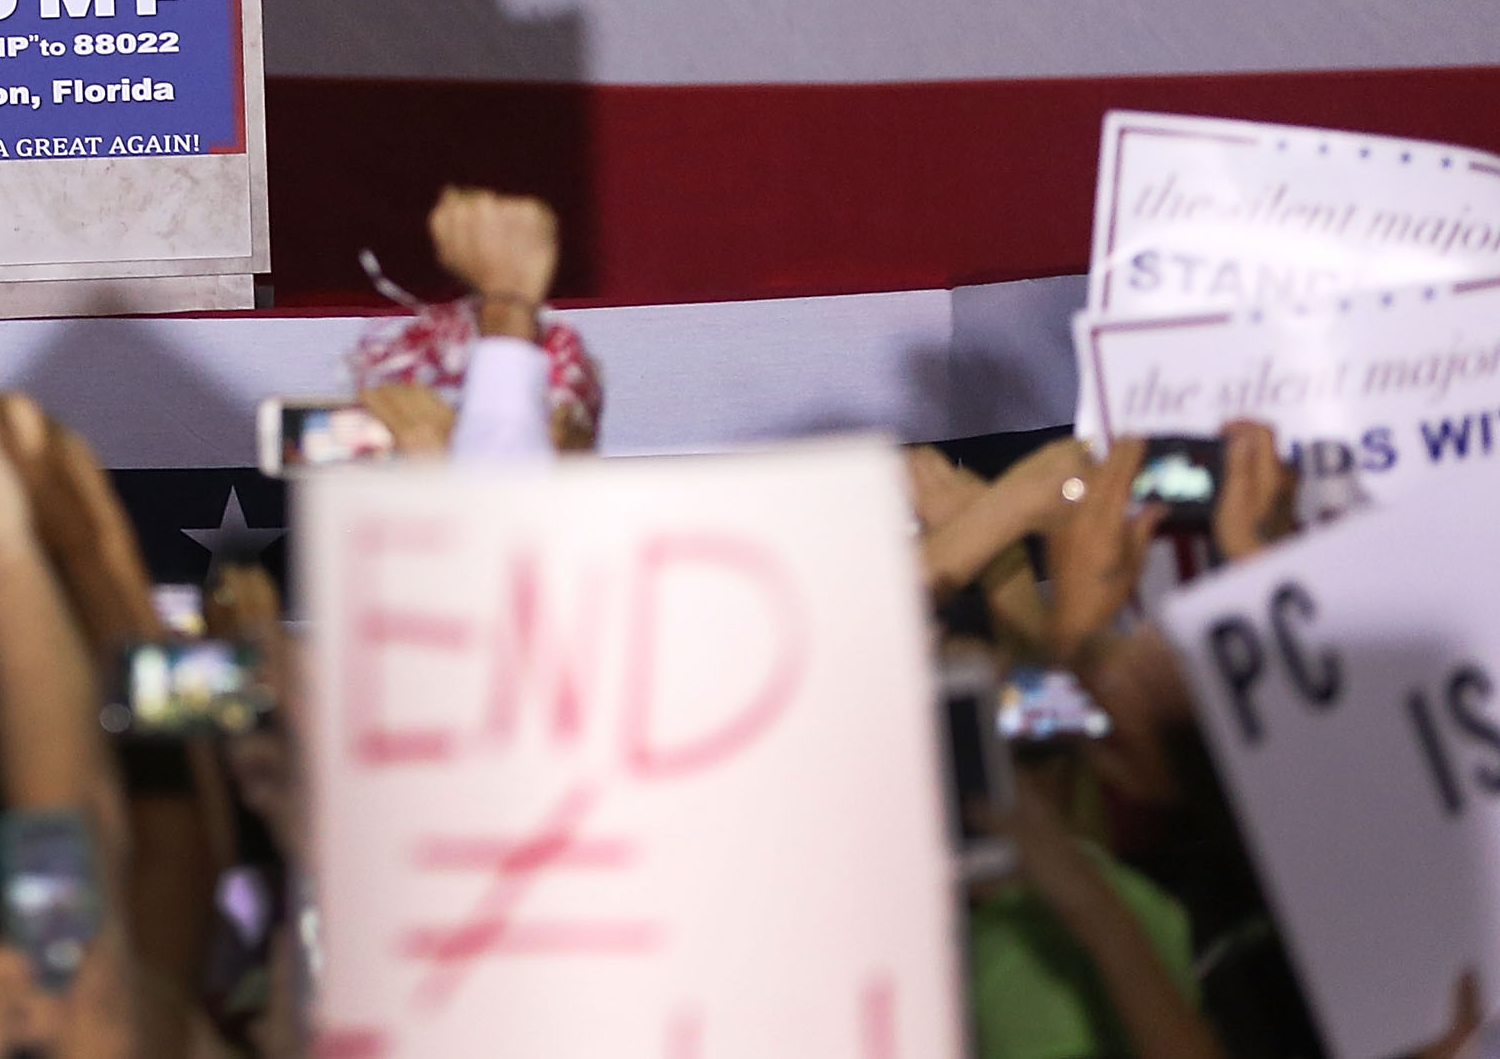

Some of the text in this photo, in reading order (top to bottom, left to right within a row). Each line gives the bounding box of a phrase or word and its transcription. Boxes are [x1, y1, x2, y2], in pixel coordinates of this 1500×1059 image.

[72, 31, 180, 55] 88022
[52, 77, 175, 105] Florida
[15, 136, 102, 158] GREAT
[108, 133, 201, 155] AGAIN!
[1419, 411, 1500, 464] WI
[342, 517, 816, 783] END
[1208, 580, 1345, 747] PC
